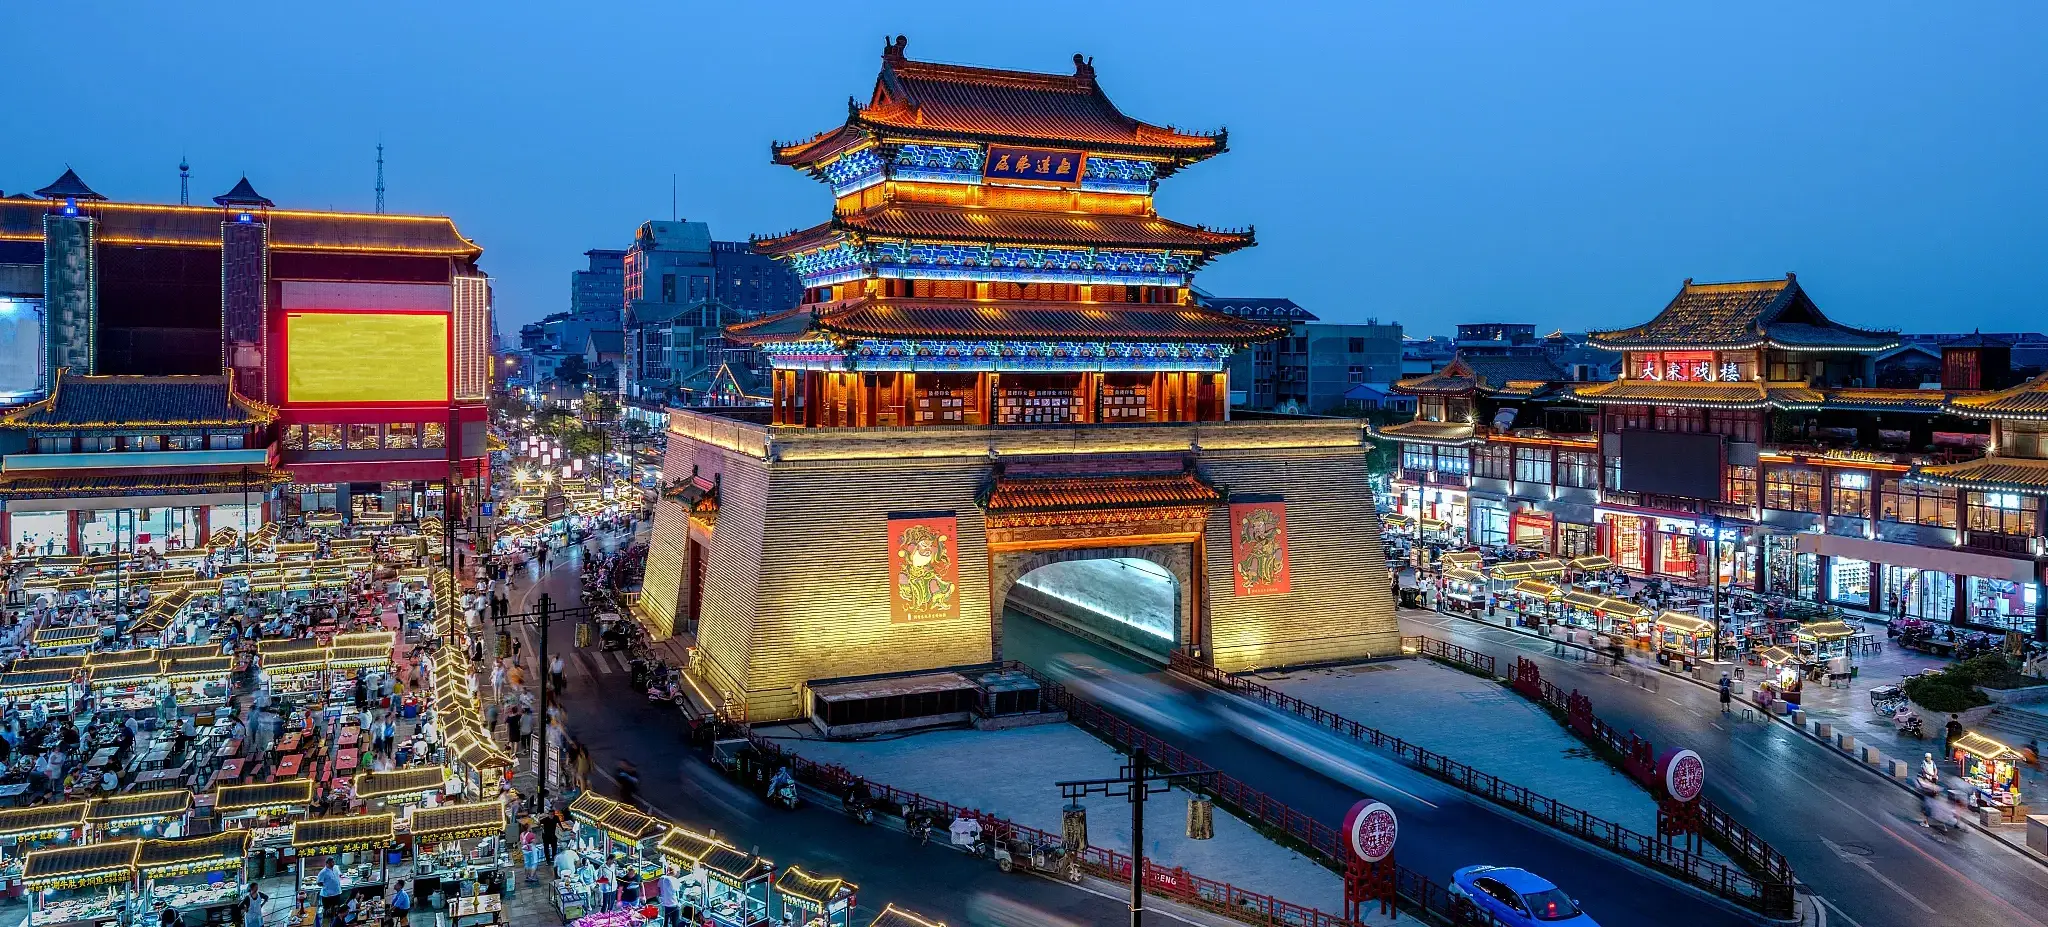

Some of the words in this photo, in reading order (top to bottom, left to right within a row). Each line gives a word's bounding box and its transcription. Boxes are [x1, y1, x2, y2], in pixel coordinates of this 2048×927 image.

[1640, 361, 1741, 382] 大宋戏楼
[342, 841, 369, 853] 羊头肉
[373, 840, 391, 850] 花生
[78, 875, 103, 888] 黄焖鱼
